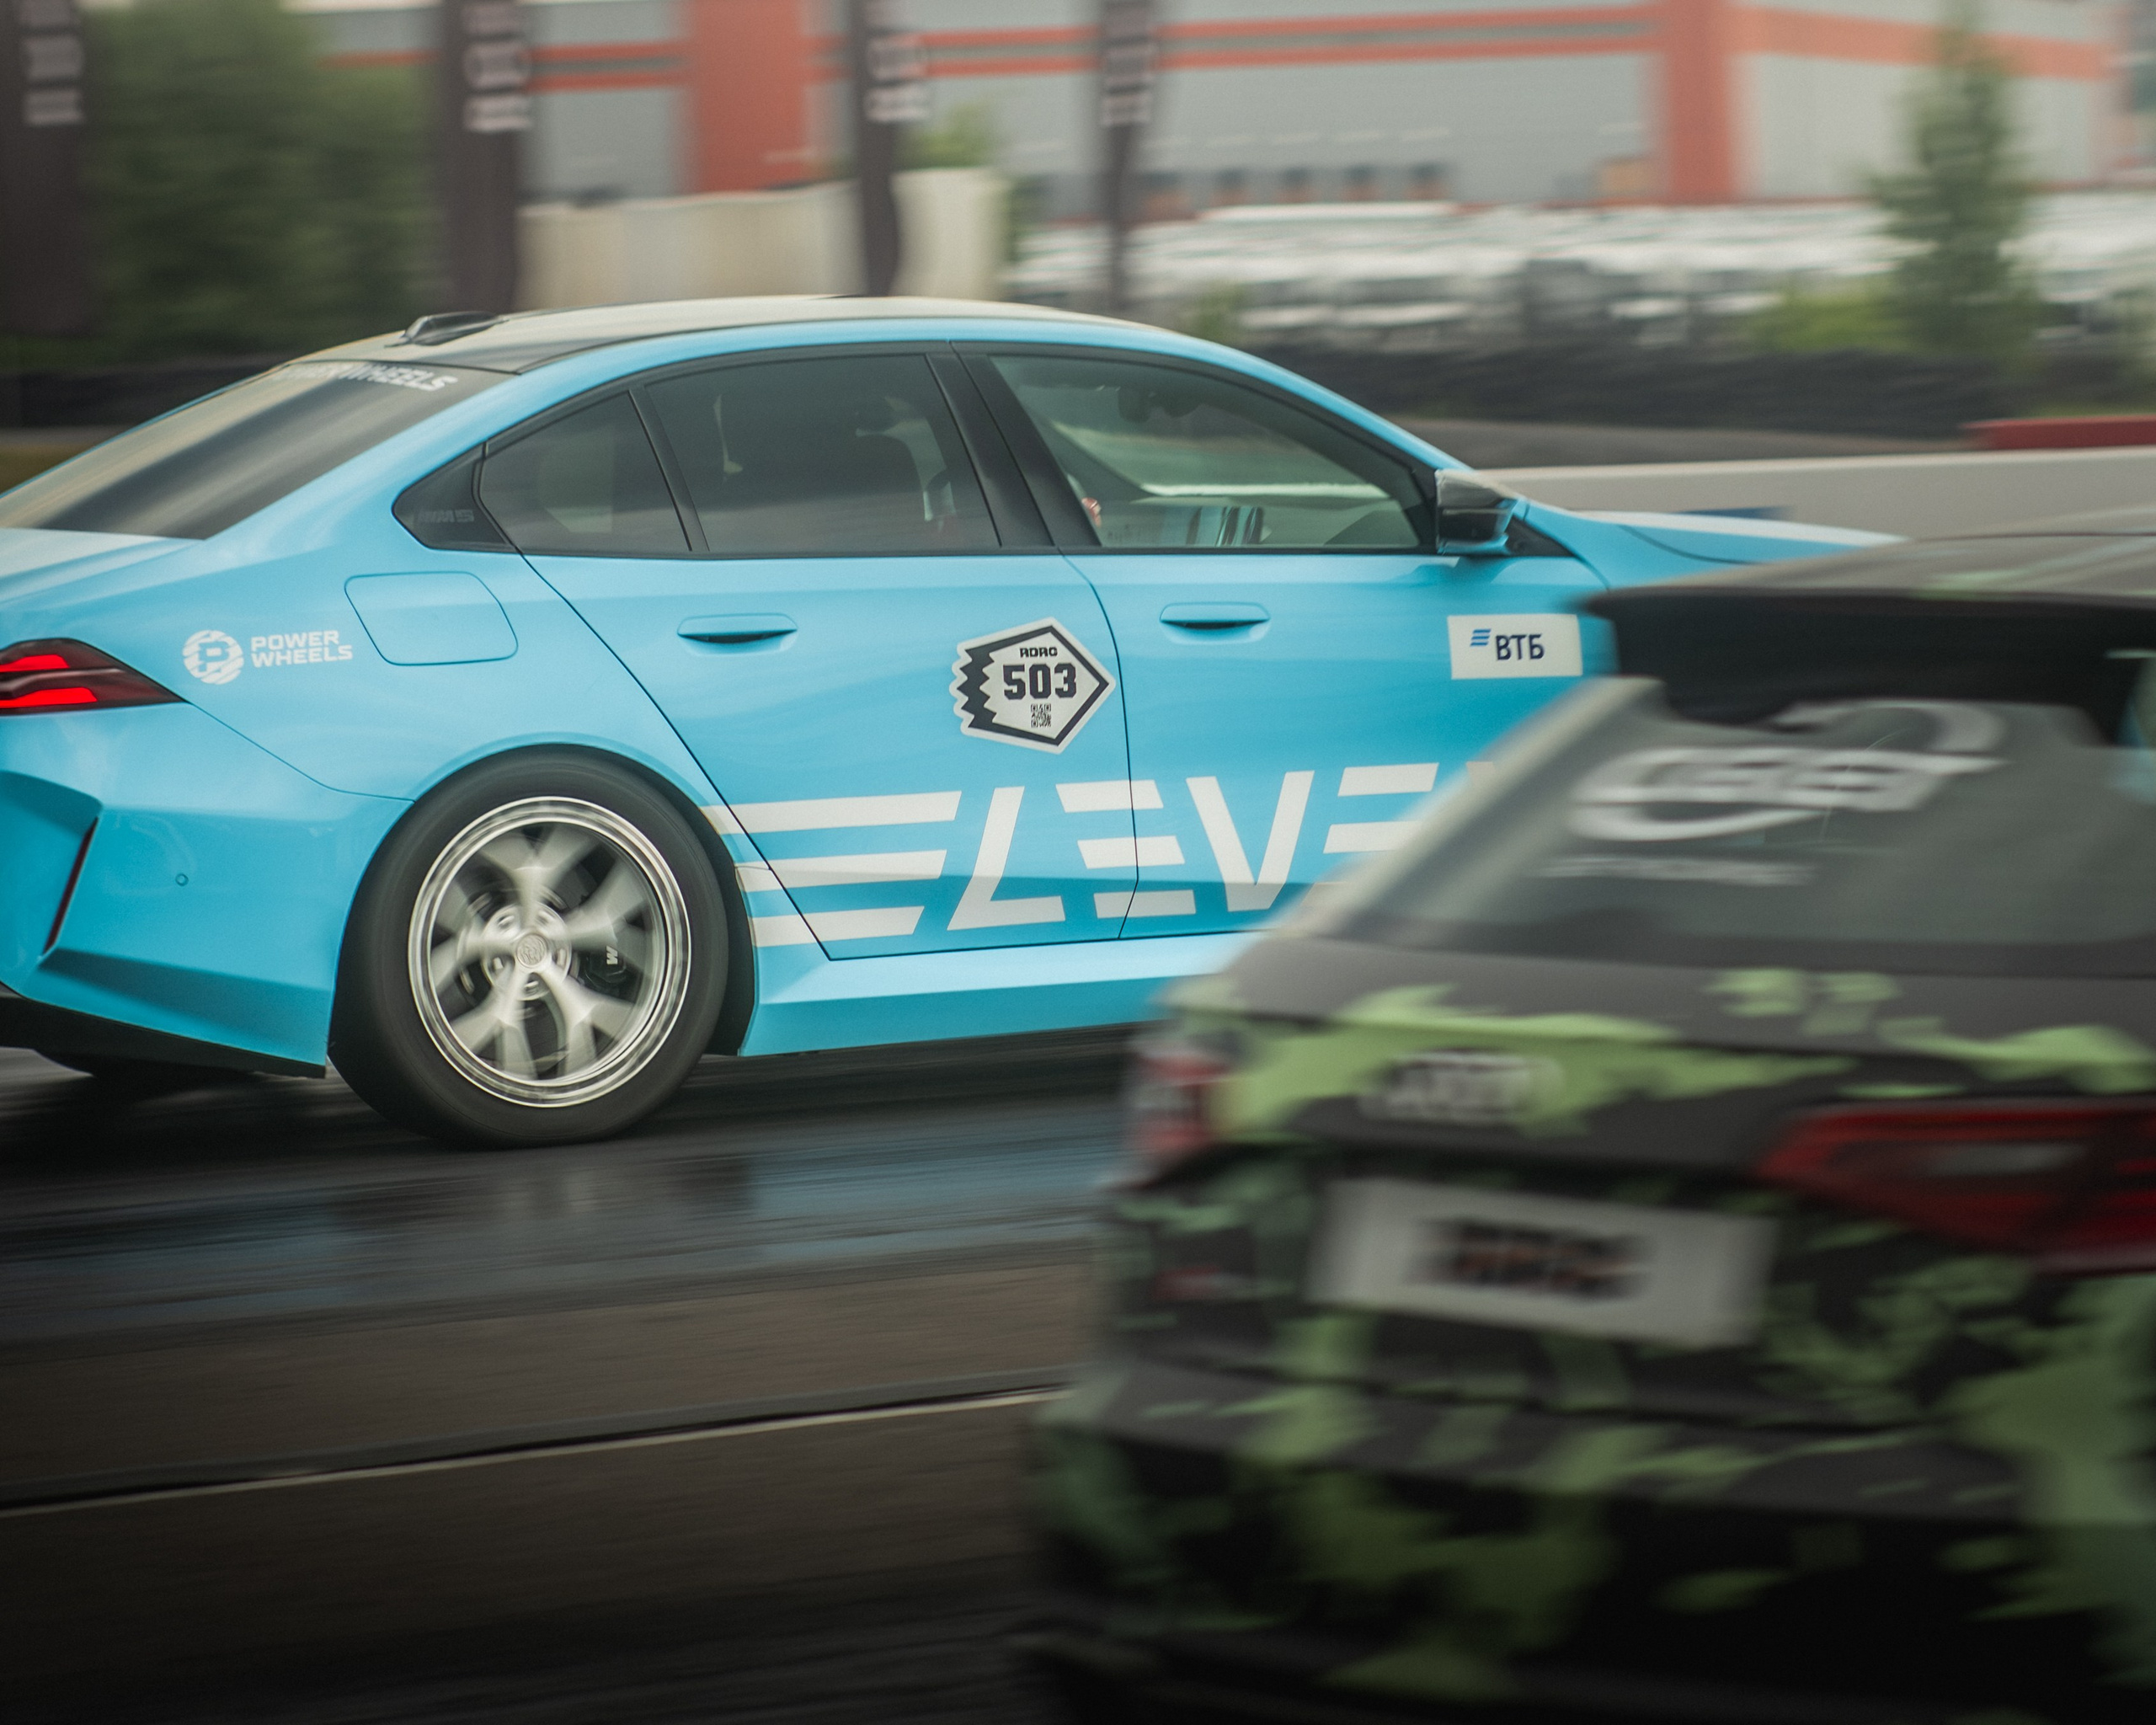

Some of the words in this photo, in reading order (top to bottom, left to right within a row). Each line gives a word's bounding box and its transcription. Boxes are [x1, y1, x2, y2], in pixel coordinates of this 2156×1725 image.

[251, 629, 339, 652] POWER
[1495, 633, 1545, 660] ВТБ
[251, 644, 353, 668] WHEELS
[1002, 662, 1077, 701] 503
